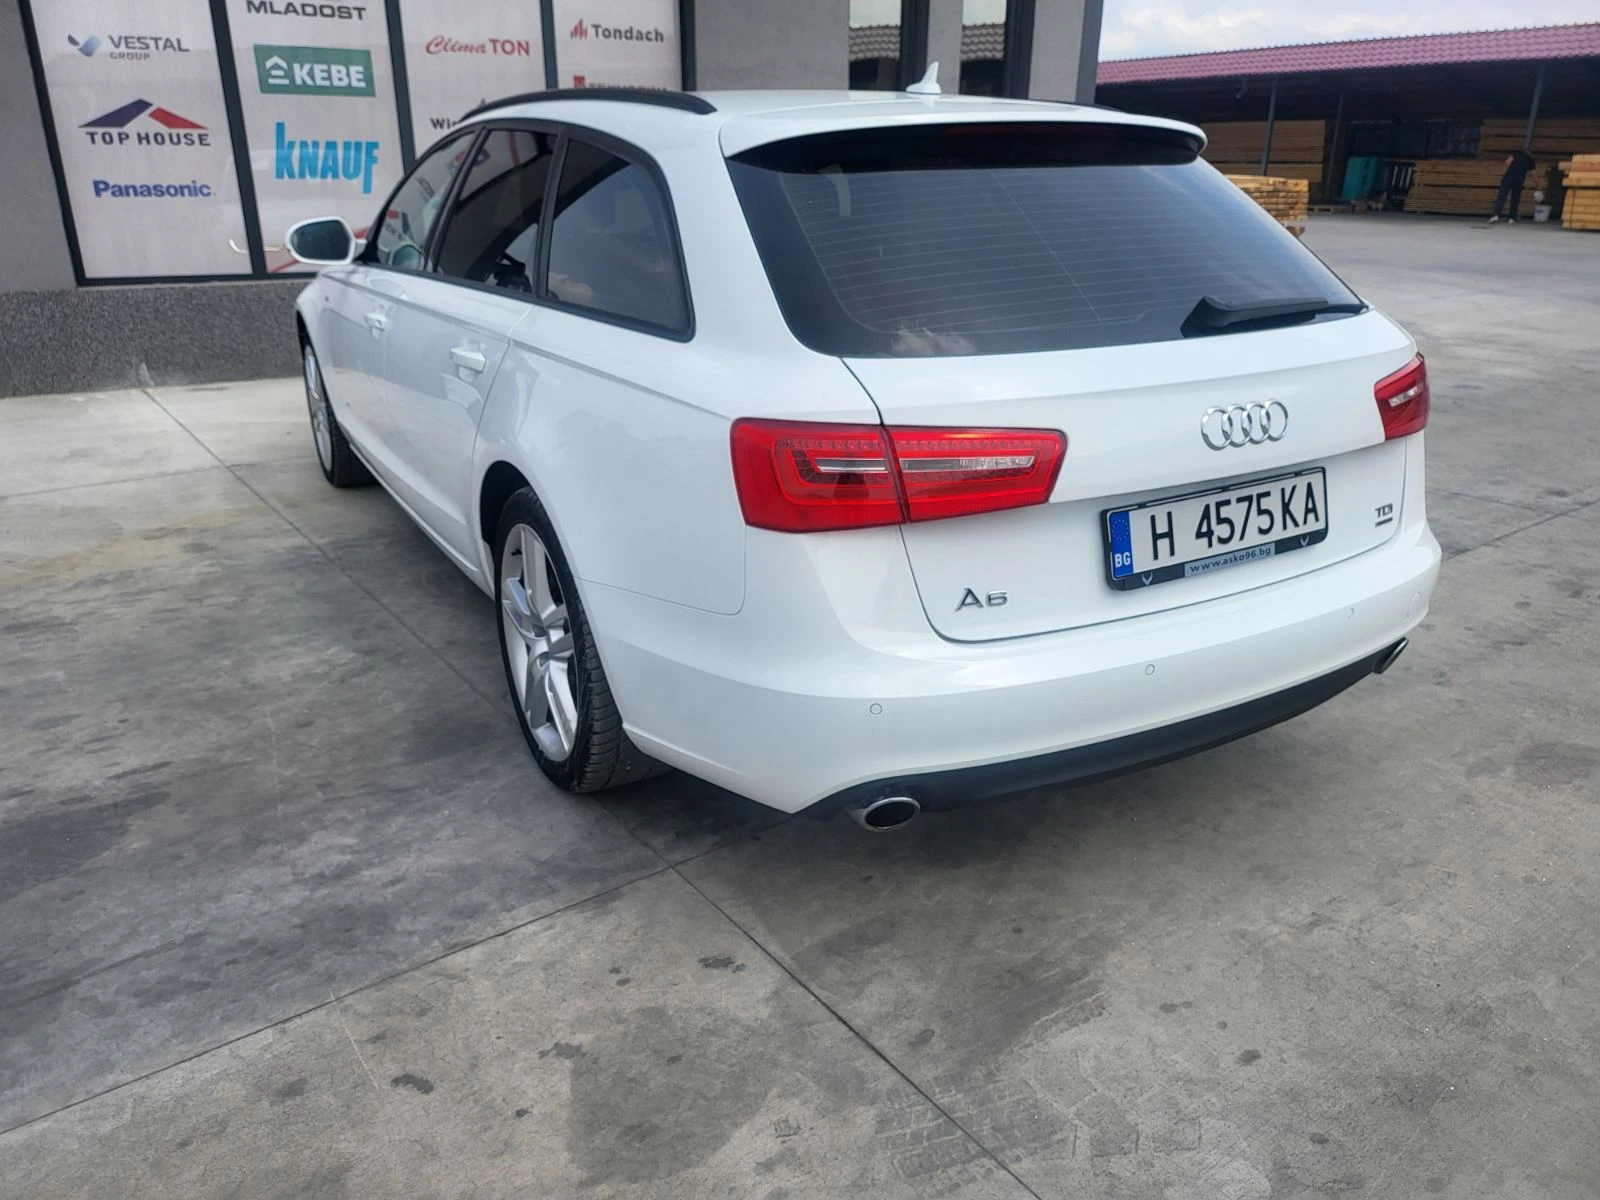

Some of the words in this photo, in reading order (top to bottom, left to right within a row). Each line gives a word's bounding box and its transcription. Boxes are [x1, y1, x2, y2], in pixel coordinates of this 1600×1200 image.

[246, 0, 366, 21] MLADOST
[591, 23, 664, 43] Tondach
[108, 34, 190, 53] VESTAL
[487, 37, 530, 56] TON
[109, 51, 150, 61] GROUP
[292, 62, 367, 88] KEBE
[86, 131, 130, 145] TOP
[137, 132, 211, 146] HOUSE
[92, 180, 212, 198] Panasonic
[1150, 510, 1175, 560] H
[1114, 551, 1131, 568] BG
[954, 587, 1008, 612] A6
